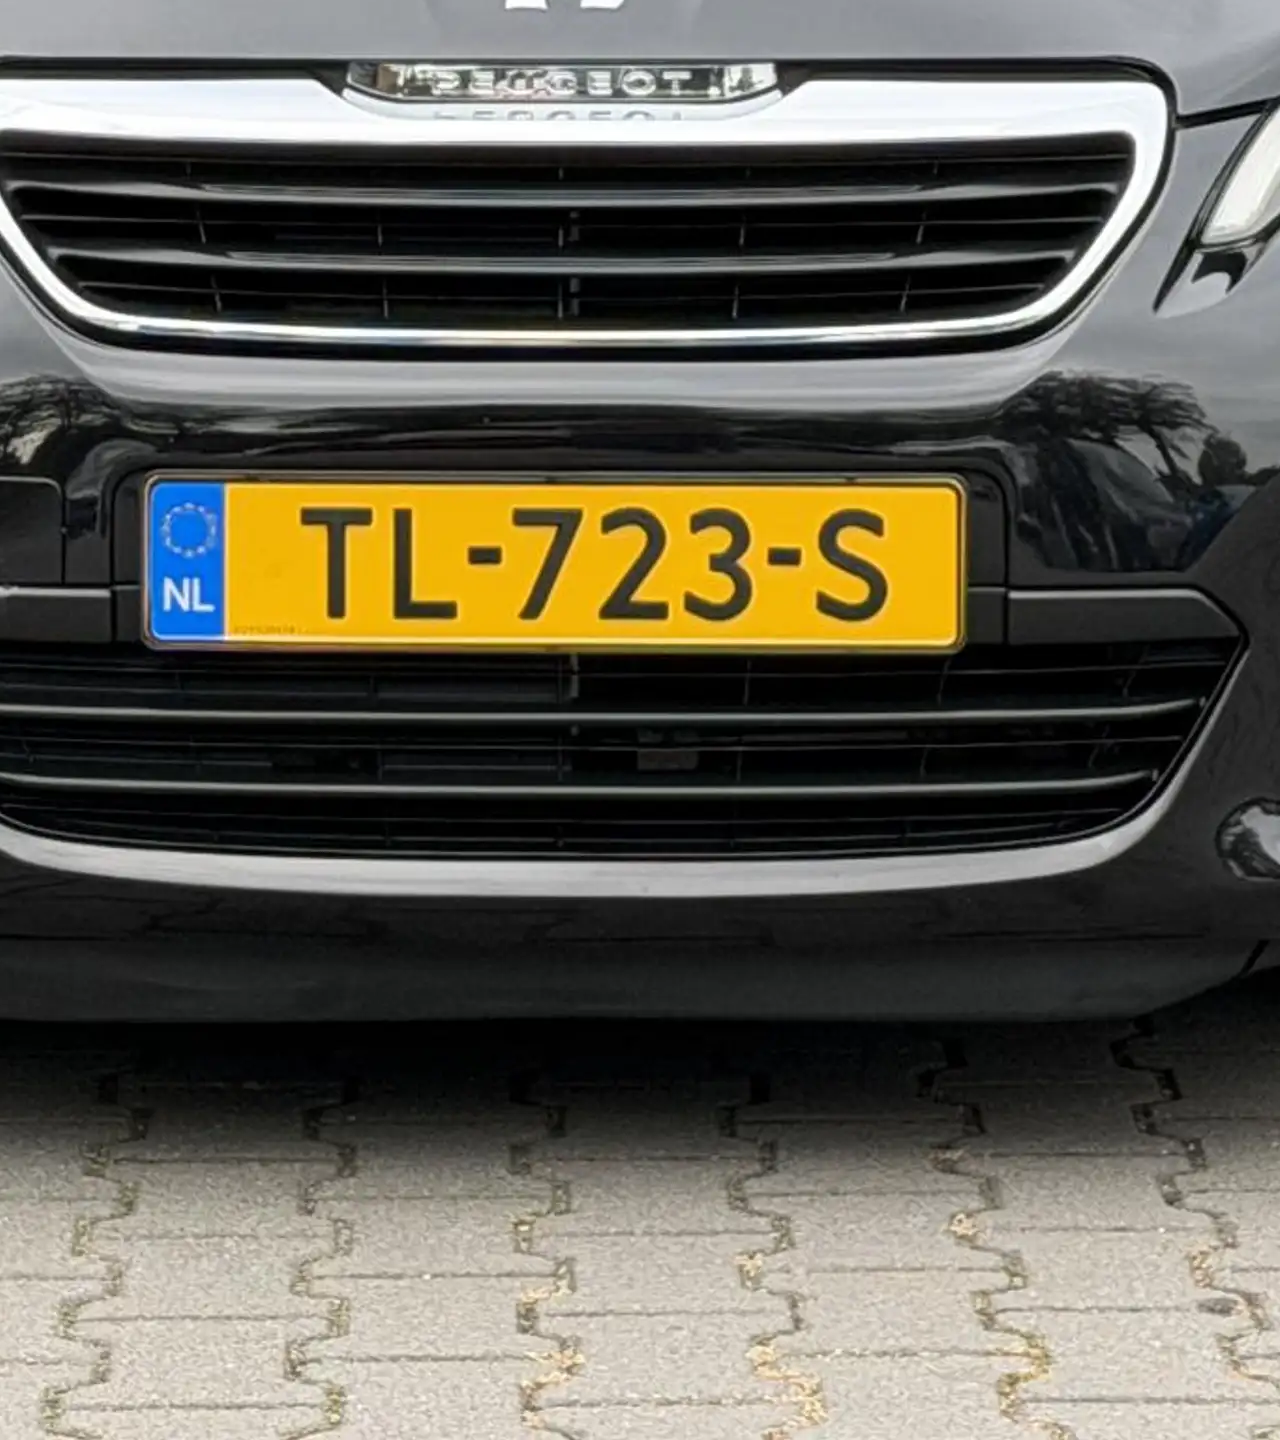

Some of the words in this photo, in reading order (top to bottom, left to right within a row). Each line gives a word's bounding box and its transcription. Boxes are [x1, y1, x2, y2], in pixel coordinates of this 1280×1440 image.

[429, 69, 693, 97] PEUGEOT
[300, 507, 888, 622] TL-723-S
[163, 576, 215, 613] NL
